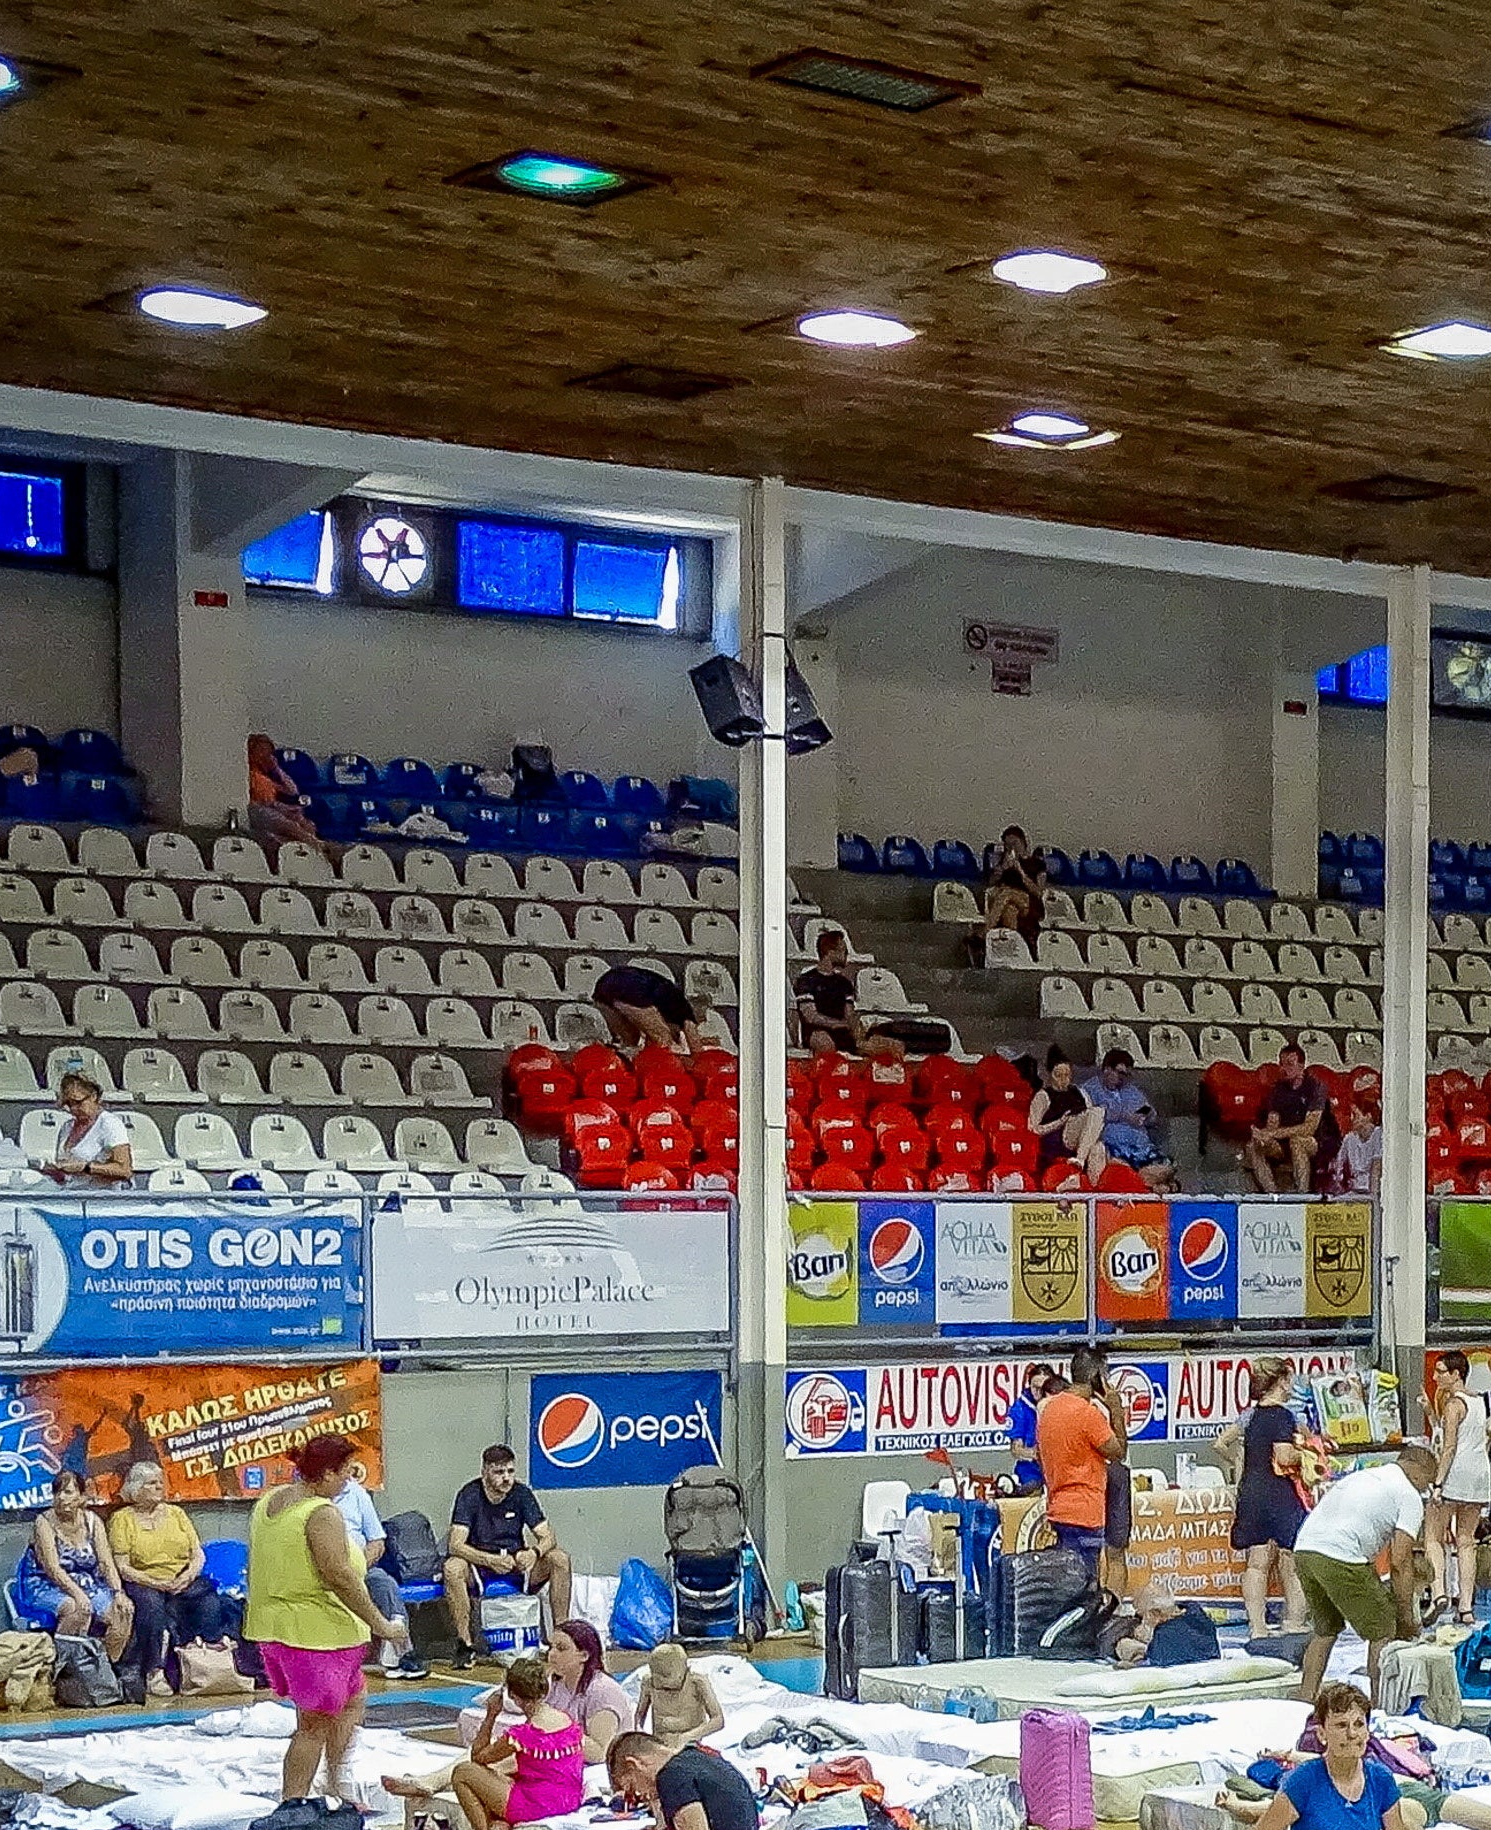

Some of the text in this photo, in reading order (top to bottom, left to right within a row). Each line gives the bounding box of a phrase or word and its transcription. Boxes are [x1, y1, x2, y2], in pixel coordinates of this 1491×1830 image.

[80, 1228, 193, 1269] OTIS
[186, 1277, 224, 1295] χωρίς
[322, 1277, 342, 1294] για
[1183, 1285, 1225, 1304] pepsi
[177, 1294, 236, 1312] ποιότητα
[875, 1287, 920, 1307] pepsi
[515, 1313, 598, 1330] HOTEL
[147, 1368, 348, 1438] ΚΑΛΩΣ ΗΡΘΑΤΕ
[610, 1406, 708, 1450] pepsi
[167, 1431, 196, 1450] Final
[878, 1435, 938, 1451] ΤΕΧΝΙΚΟΣ
[939, 1432, 994, 1448] ΕΛΕΓΧΟΣ
